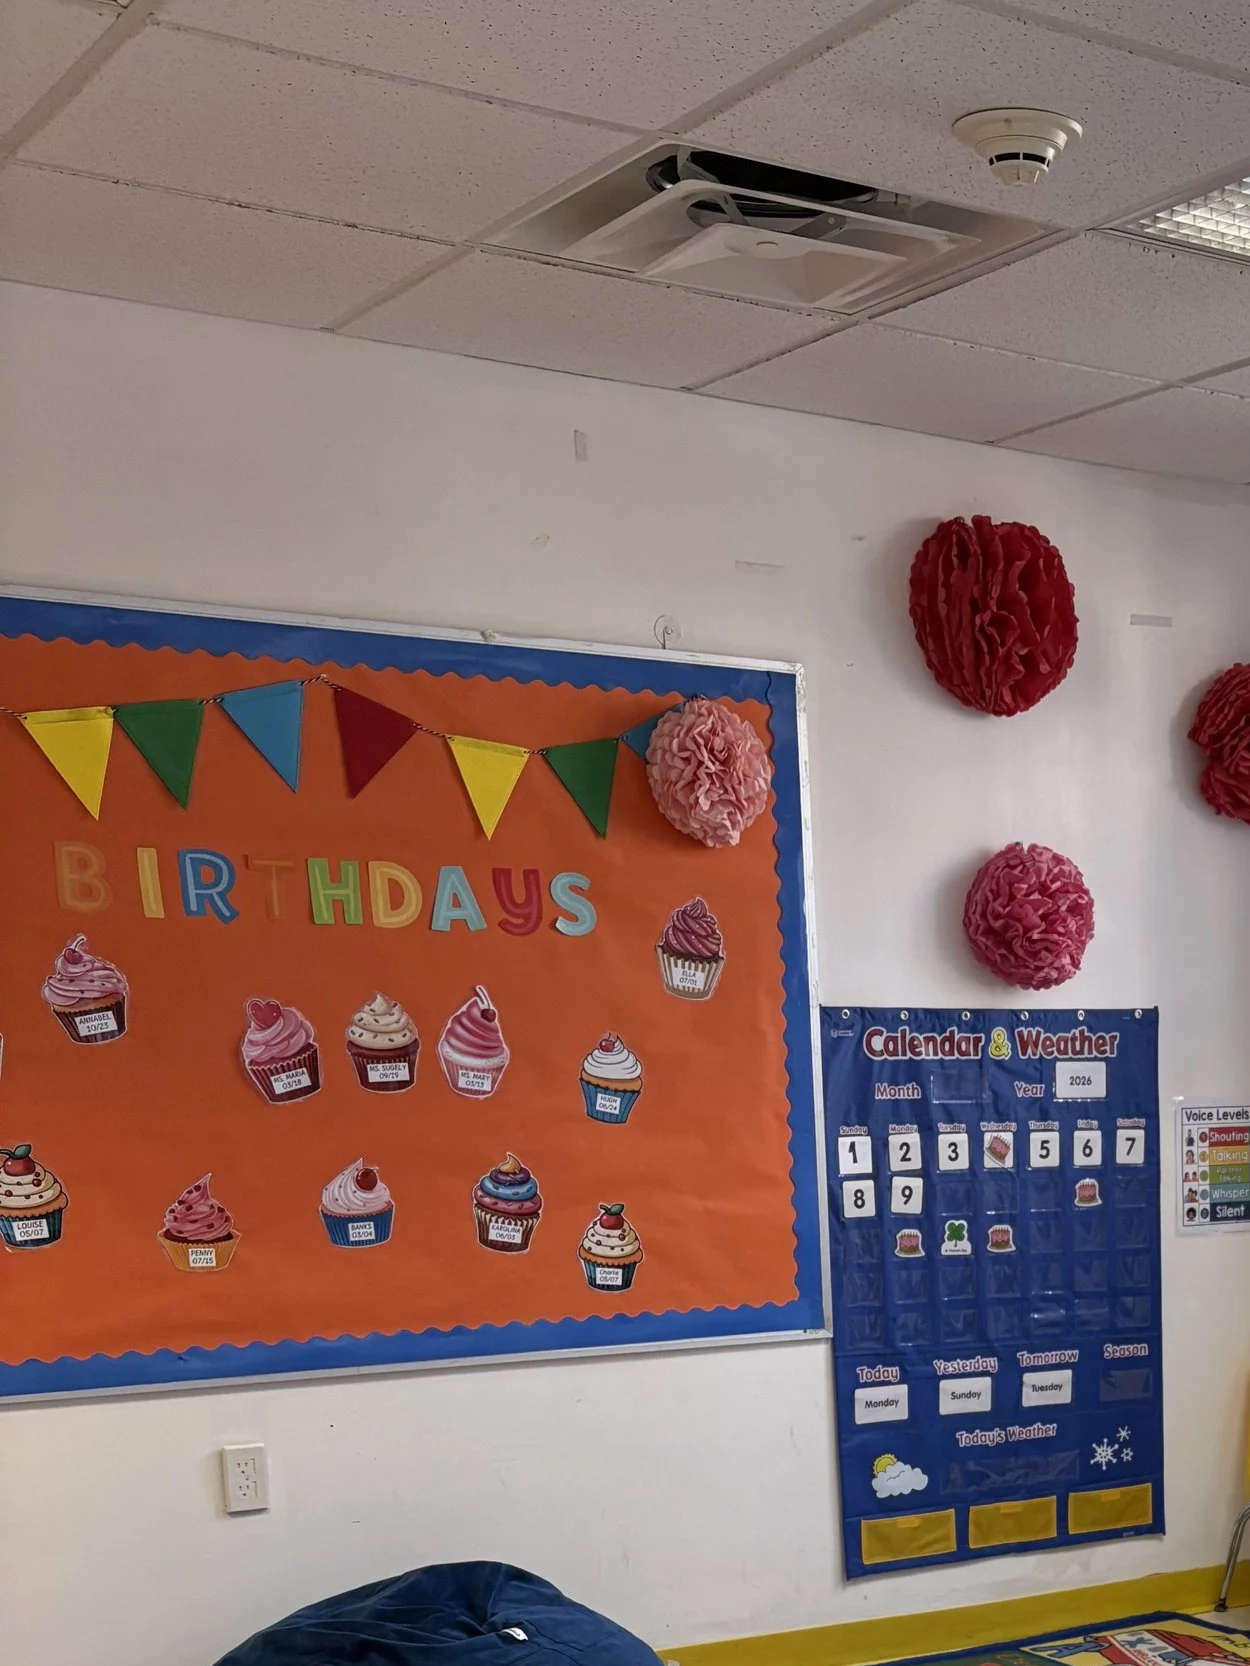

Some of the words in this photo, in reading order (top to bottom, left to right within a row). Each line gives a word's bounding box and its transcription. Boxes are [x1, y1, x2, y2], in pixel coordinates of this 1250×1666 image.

[52, 840, 598, 937] BIRTHDAYS
[78, 1013, 111, 1025] ANNABEL
[86, 1022, 109, 1033] 10/23
[864, 1027, 983, 1061] Calendar
[989, 1028, 1011, 1060] &
[1016, 1026, 1120, 1058] Weather
[286, 1069, 306, 1081] MARIA
[472, 1073, 490, 1082] MARY
[1068, 1075, 1093, 1087] 2026
[875, 1083, 921, 1100] Month
[1015, 1081, 1045, 1098] Year
[1185, 1110, 1213, 1122] Voice
[1216, 1108, 1250, 1121] Levels
[840, 1125, 868, 1136] Sunday
[889, 1124, 918, 1134] Monday
[980, 1121, 1017, 1132] Wednesday
[1028, 1120, 1059, 1131] Thursday
[1209, 1131, 1250, 1143] Shouting
[848, 1141, 858, 1164] 1
[899, 1141, 912, 1162] 2
[947, 1141, 960, 1162] 3
[1038, 1140, 1051, 1160] 5
[1081, 1138, 1094, 1158] 6
[1125, 1137, 1137, 1156] 7
[1211, 1150, 1248, 1162] Talking
[853, 1189, 866, 1209] 8
[901, 1185, 914, 1205] 9
[1211, 1188, 1250, 1200] Whisper
[1216, 1204, 1245, 1218] Silent
[17, 1220, 44, 1230] LOUISE
[351, 1223, 372, 1231] BANKS
[19, 1229, 44, 1238] 05/07
[190, 1248, 214, 1257] PENNY
[857, 1365, 900, 1383] Today
[933, 1355, 998, 1376] Yesterday
[1017, 1350, 1079, 1368] Tomorrow
[1104, 1343, 1149, 1359] Season
[1031, 1381, 1063, 1393] Tuesday
[950, 1389, 982, 1401] Sunday
[864, 1397, 900, 1410] Monday
[956, 1428, 1005, 1448] Today's
[1007, 1423, 1057, 1442] Weather
